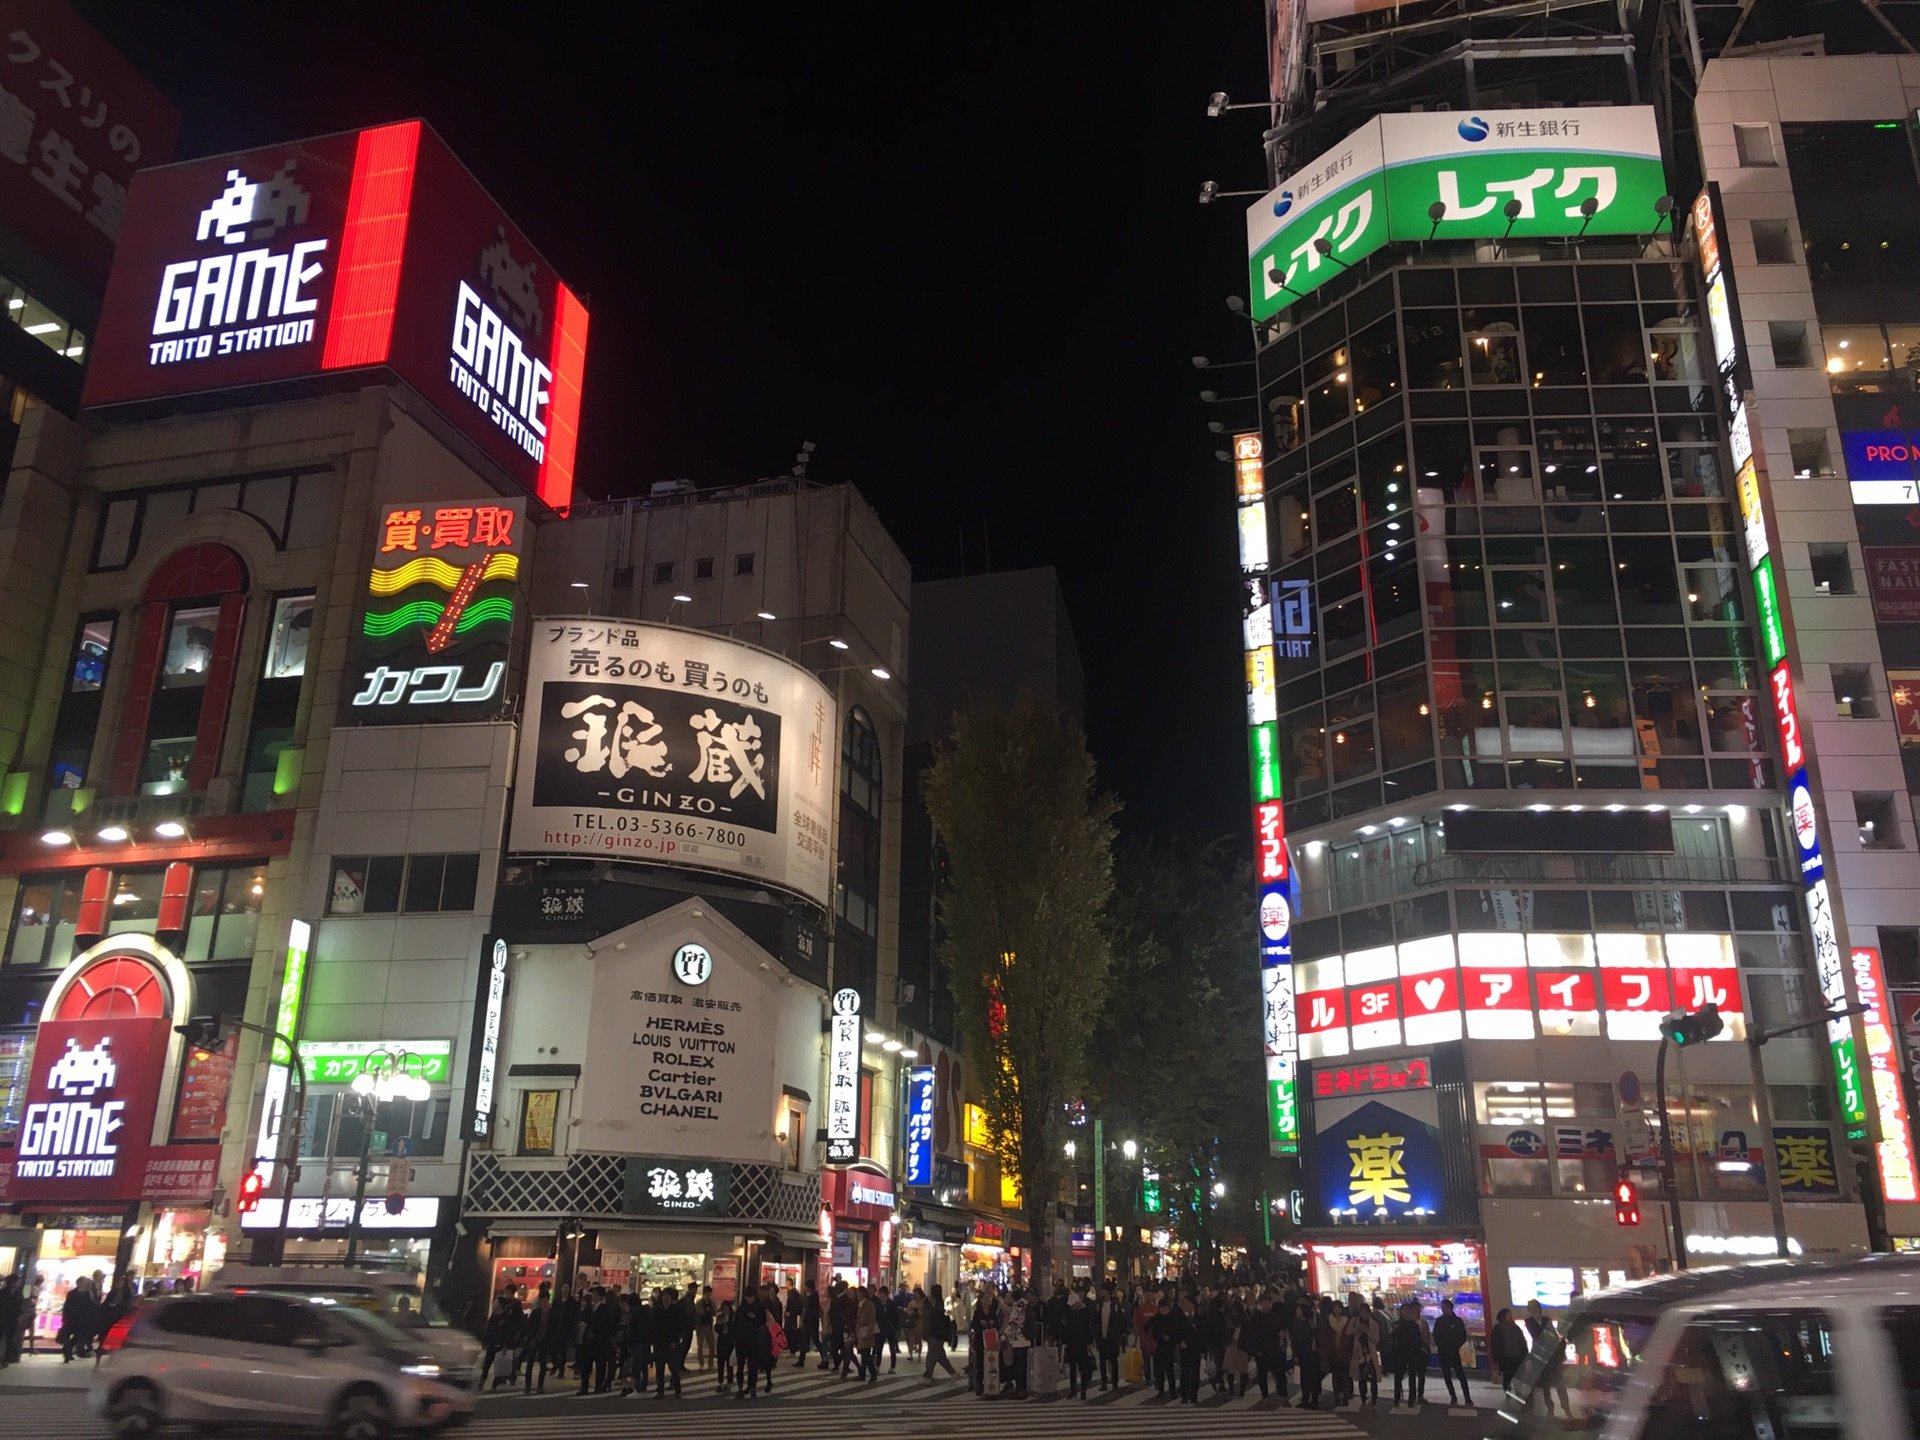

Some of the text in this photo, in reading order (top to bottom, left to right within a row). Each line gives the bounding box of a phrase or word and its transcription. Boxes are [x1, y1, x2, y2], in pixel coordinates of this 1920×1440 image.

[8, 30, 141, 163] クスリの
[1496, 119, 1580, 138] 新生銀行
[1296, 149, 1354, 201] 新生銀行
[1437, 166, 1618, 221] レイク
[1264, 189, 1373, 300] レイク
[152, 238, 330, 337] GAME
[149, 319, 316, 365] TAITO STATION
[451, 280, 552, 437] GAME
[448, 356, 545, 465] TAITO STATION
[381, 506, 514, 552] 質・買取
[549, 626, 640, 648] ブランド品
[352, 661, 507, 706] カワノ
[1773, 667, 1801, 767] アイフル
[560, 694, 766, 800] 銀蔵
[544, 830, 676, 852] http://ginzo.jp
[573, 814, 746, 848] TEL.03-5366-7800
[1259, 806, 1283, 879] アイフル
[1813, 891, 1843, 995] 大勝軒
[630, 990, 742, 1012] 高価買取 激安販売
[646, 1016, 725, 1036] HERMÈS
[1265, 972, 1297, 1048] 大勝軒
[1311, 974, 1727, 1029] ル 3F アイフル
[632, 1033, 736, 1054] LOUIS VUITTON
[653, 1051, 715, 1068] ROLEX
[534, 1094, 551, 1107] 2F
[640, 1085, 722, 1103] BVLGARI
[648, 1069, 716, 1086] Cartier
[1838, 1048, 1858, 1113] レイク
[20, 1101, 125, 1155] GAME
[640, 1102, 719, 1120] CHANEL
[921, 1085, 932, 1141] クロサワ
[1277, 1084, 1296, 1133] レイク
[17, 1159, 115, 1177] TAITO STATION
[647, 1168, 715, 1202] 銀蔵
[1346, 1133, 1411, 1205] 薬
[1775, 1135, 1836, 1187] 薬
